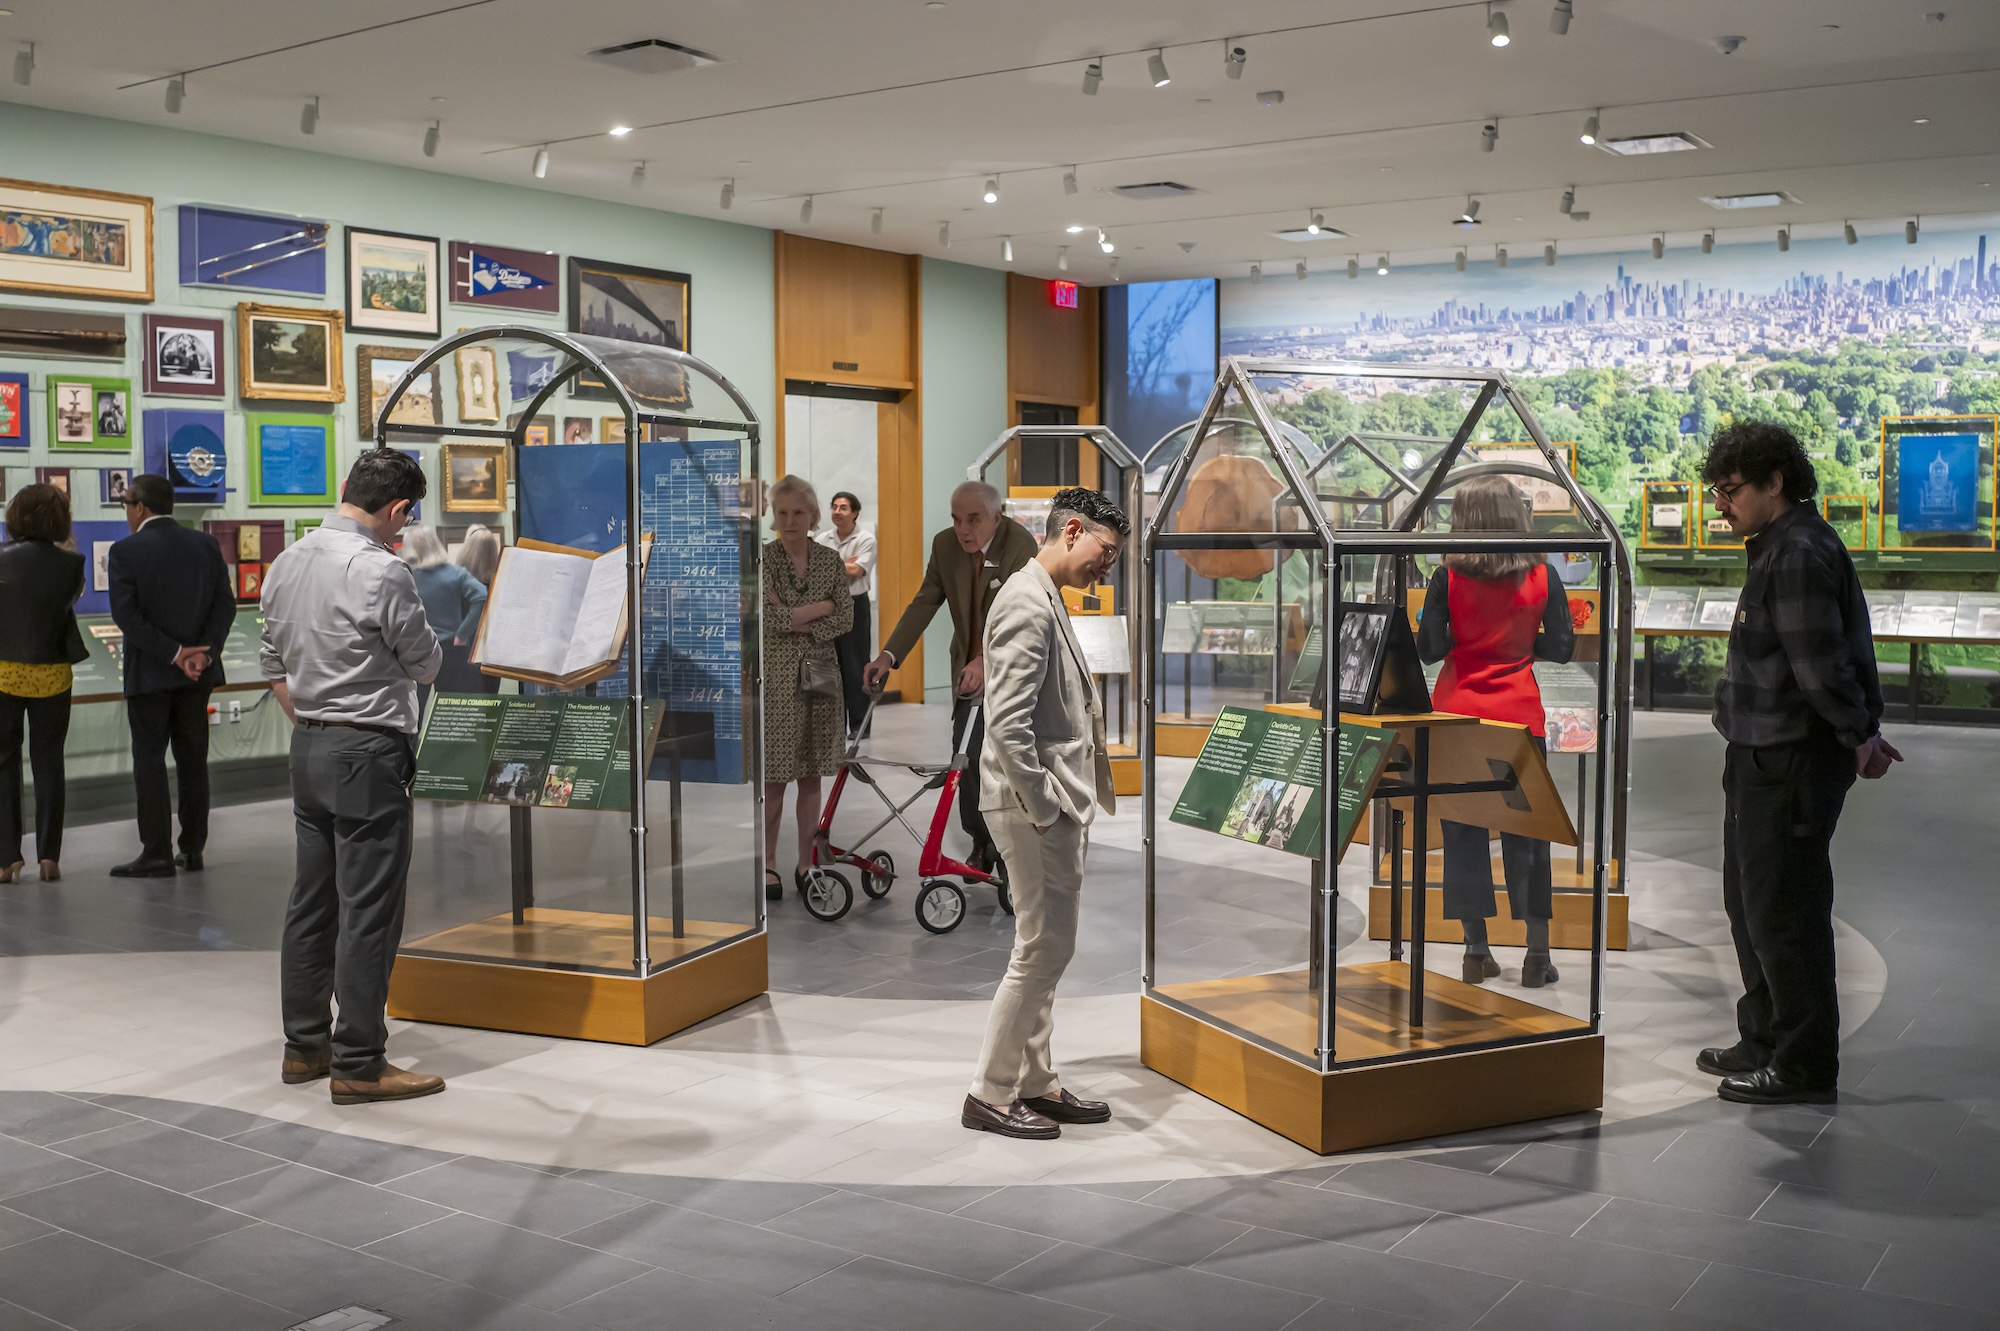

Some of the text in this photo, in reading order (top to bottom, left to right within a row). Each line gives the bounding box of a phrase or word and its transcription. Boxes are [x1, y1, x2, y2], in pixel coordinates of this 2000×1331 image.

[705, 472, 740, 486] 9932
[682, 565, 718, 577] 9464
[697, 625, 726, 640] 3413
[686, 687, 724, 702] 3414
[461, 698, 467, 706] IN
